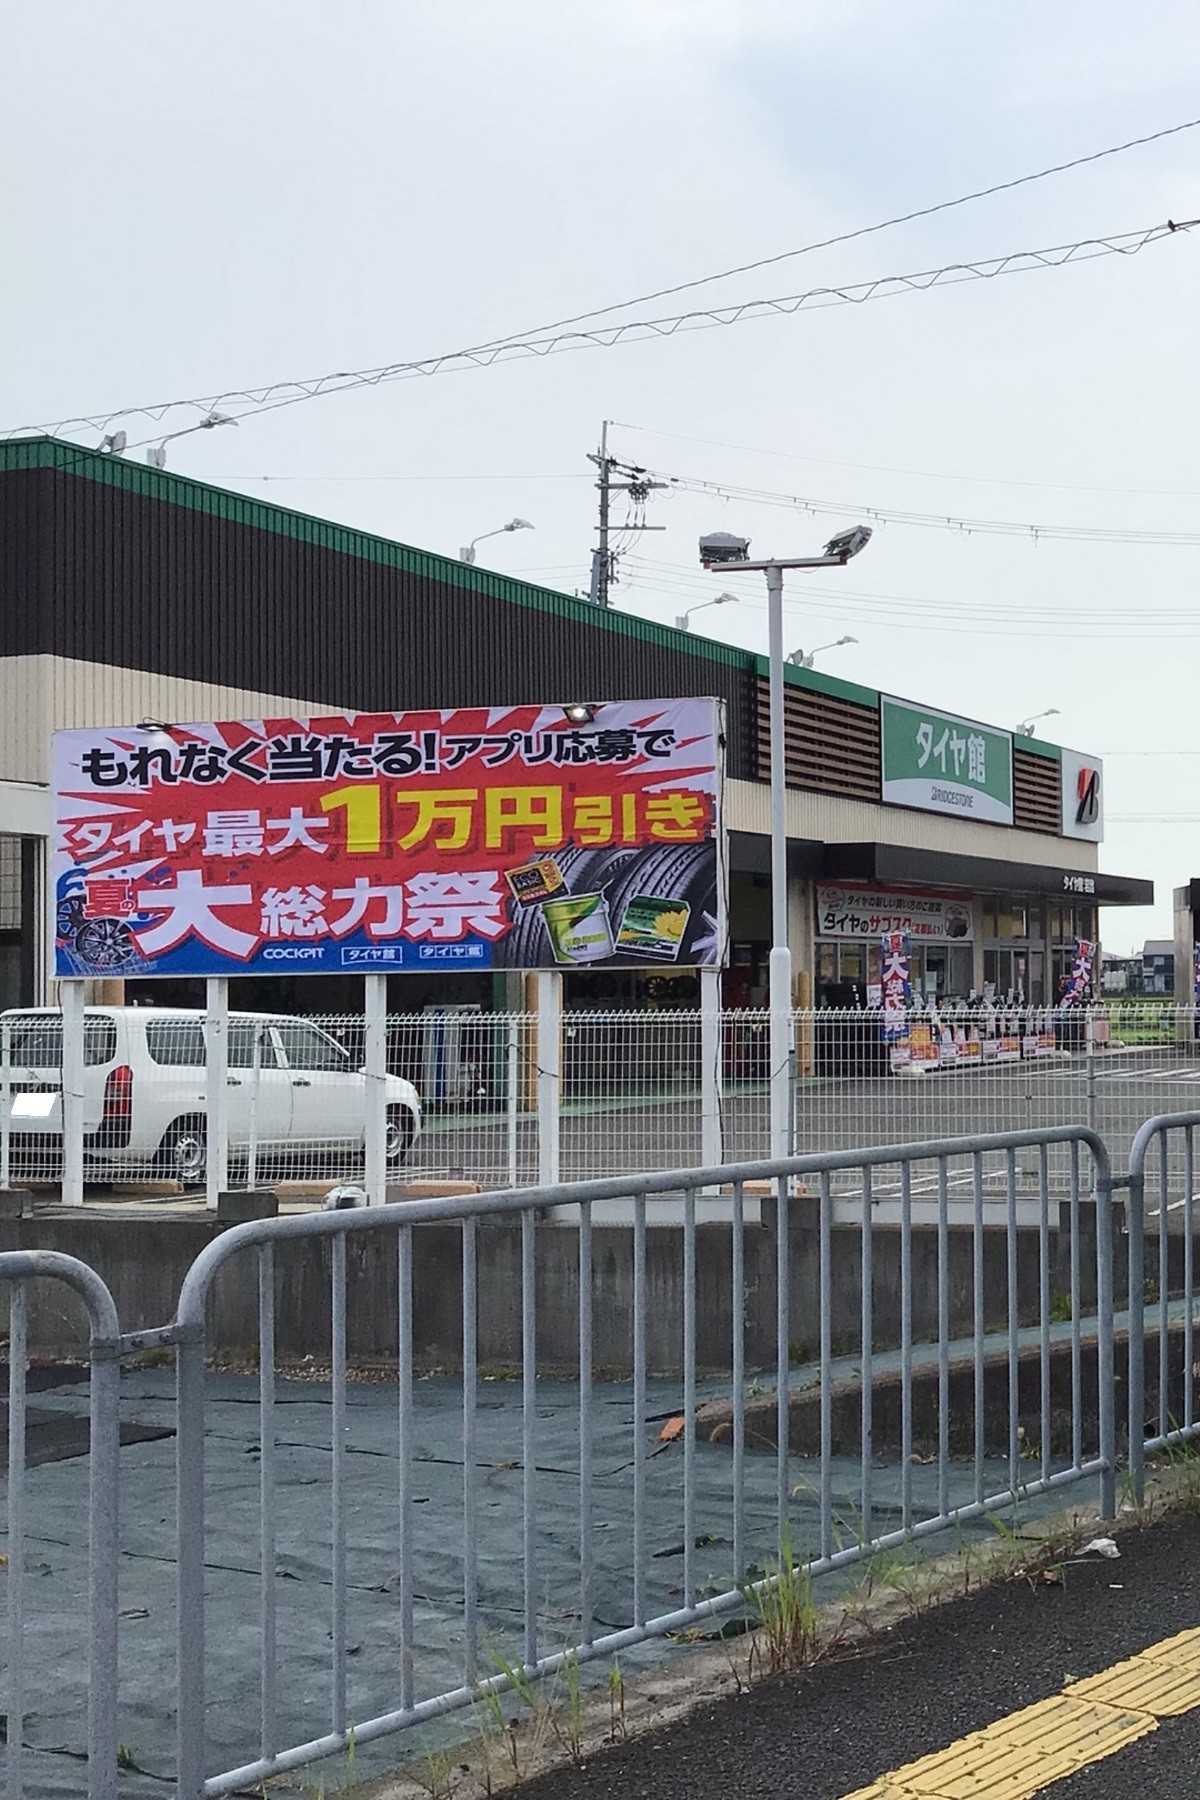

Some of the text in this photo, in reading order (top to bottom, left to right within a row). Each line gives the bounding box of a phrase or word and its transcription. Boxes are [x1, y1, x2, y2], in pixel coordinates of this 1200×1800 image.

[916, 722, 986, 784] タイヤ館
[931, 785, 974, 808] BRIDGESTONE
[262, 947, 325, 959] COCKPIT
[349, 949, 396, 960] タイヤ館
